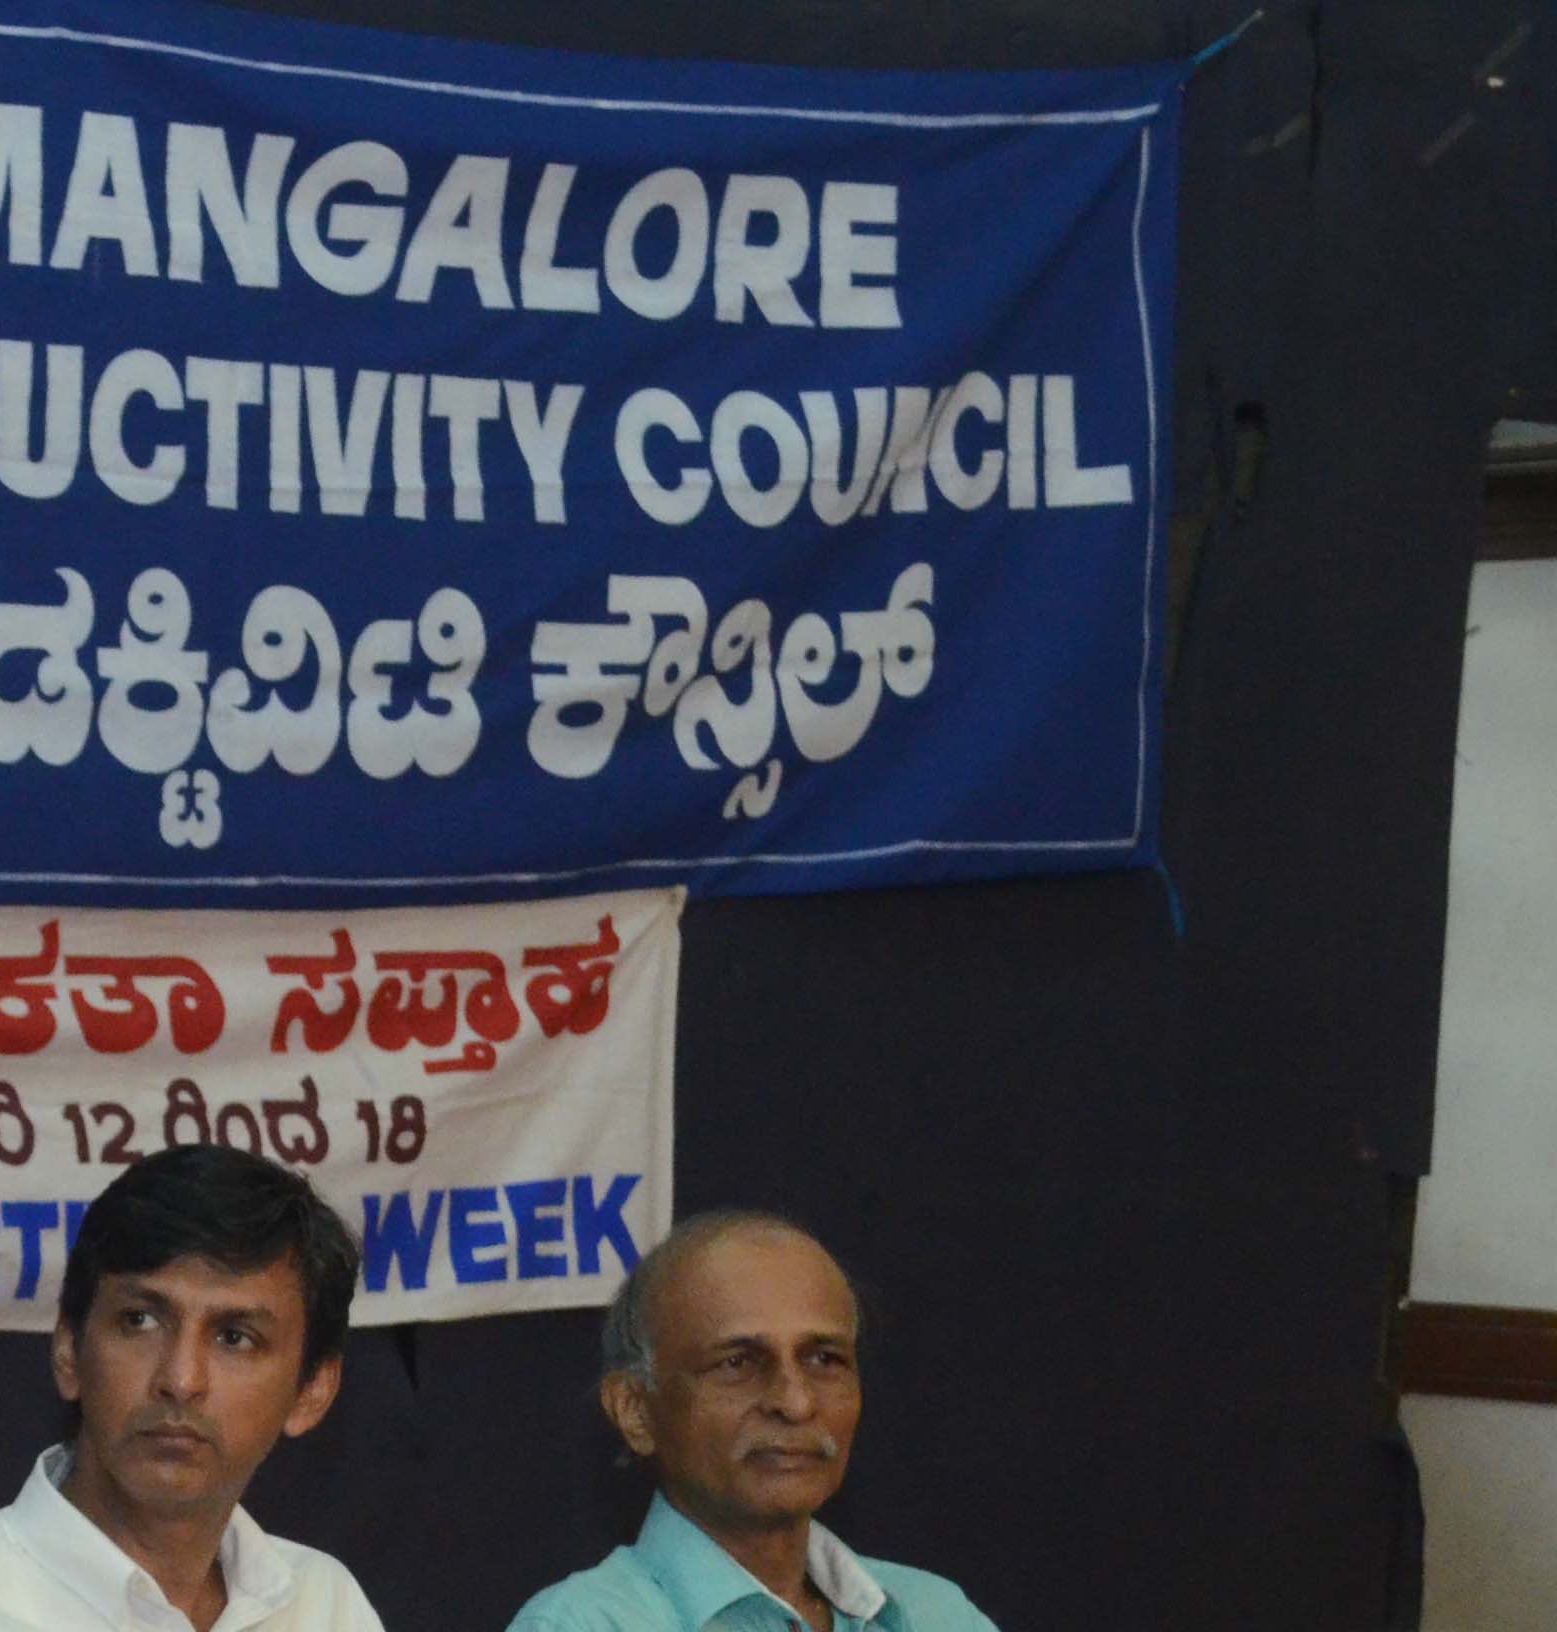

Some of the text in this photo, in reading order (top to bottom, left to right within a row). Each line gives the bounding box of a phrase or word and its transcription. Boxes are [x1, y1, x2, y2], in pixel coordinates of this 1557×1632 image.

[613, 370, 1133, 527] COUNCIL
[265, 914, 620, 1075] ಸಪ್ತಾಹ
[64, 1102, 144, 1165] 12
[356, 1095, 427, 1165] 18
[362, 1174, 642, 1293] WEEK
